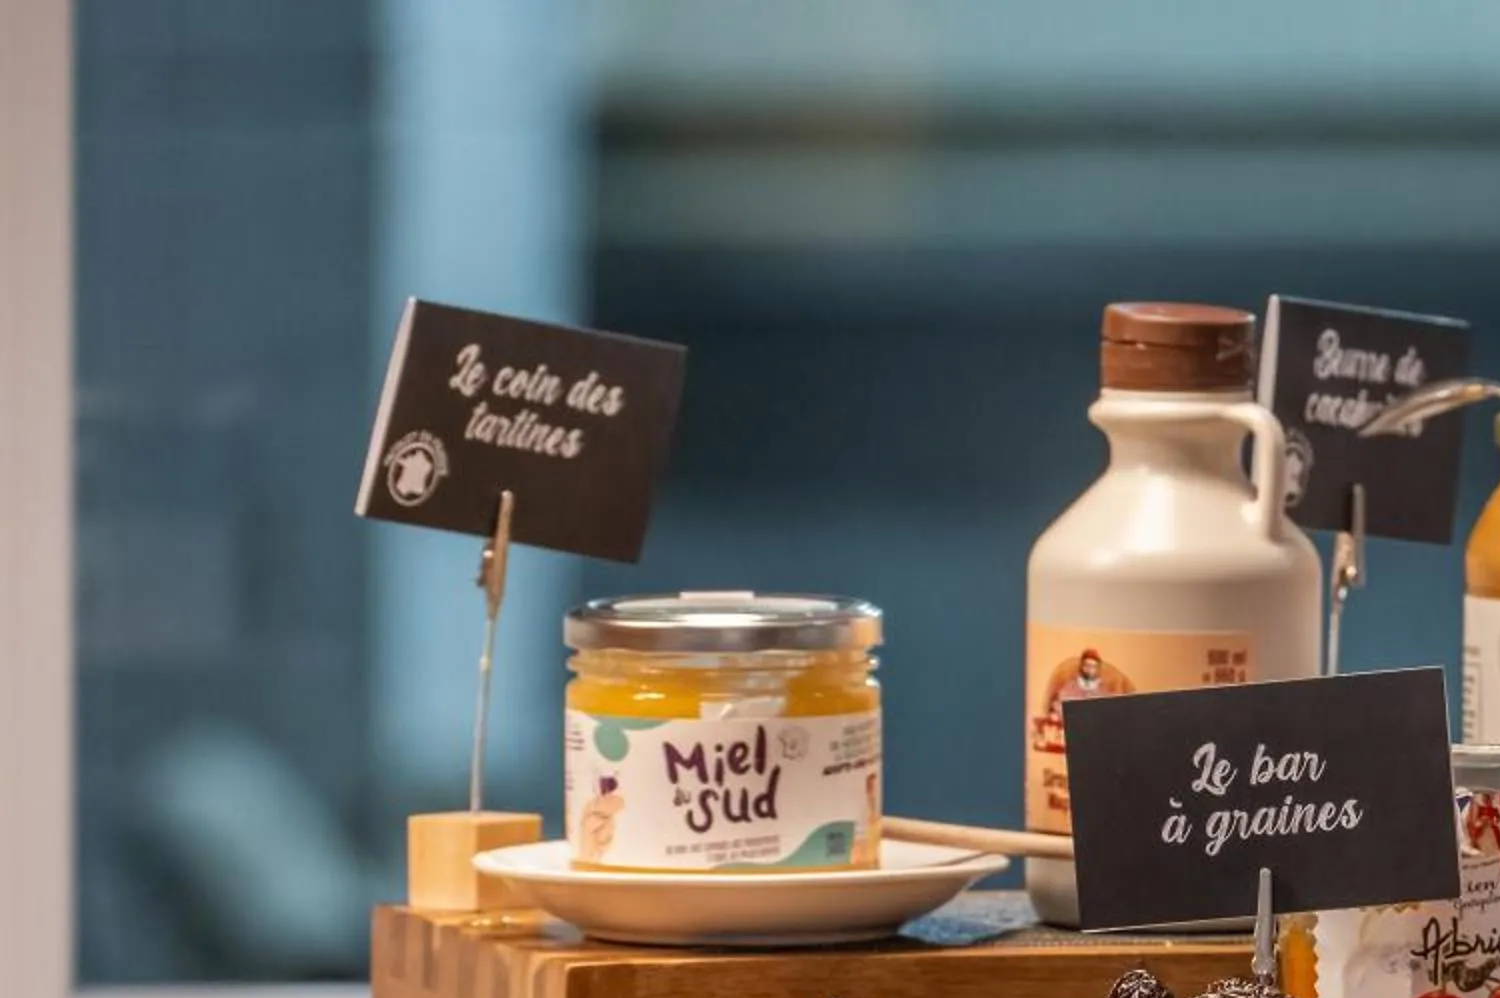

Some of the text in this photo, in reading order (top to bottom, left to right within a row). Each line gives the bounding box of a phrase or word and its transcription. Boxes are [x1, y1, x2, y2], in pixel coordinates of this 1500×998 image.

[449, 343, 623, 416] Le coin des
[1394, 345, 1424, 387] de
[464, 401, 583, 459] tartines
[663, 724, 767, 787] Miel
[1191, 742, 1327, 795] Le bar
[686, 764, 781, 834] Sud
[1161, 795, 1363, 857] à graines
